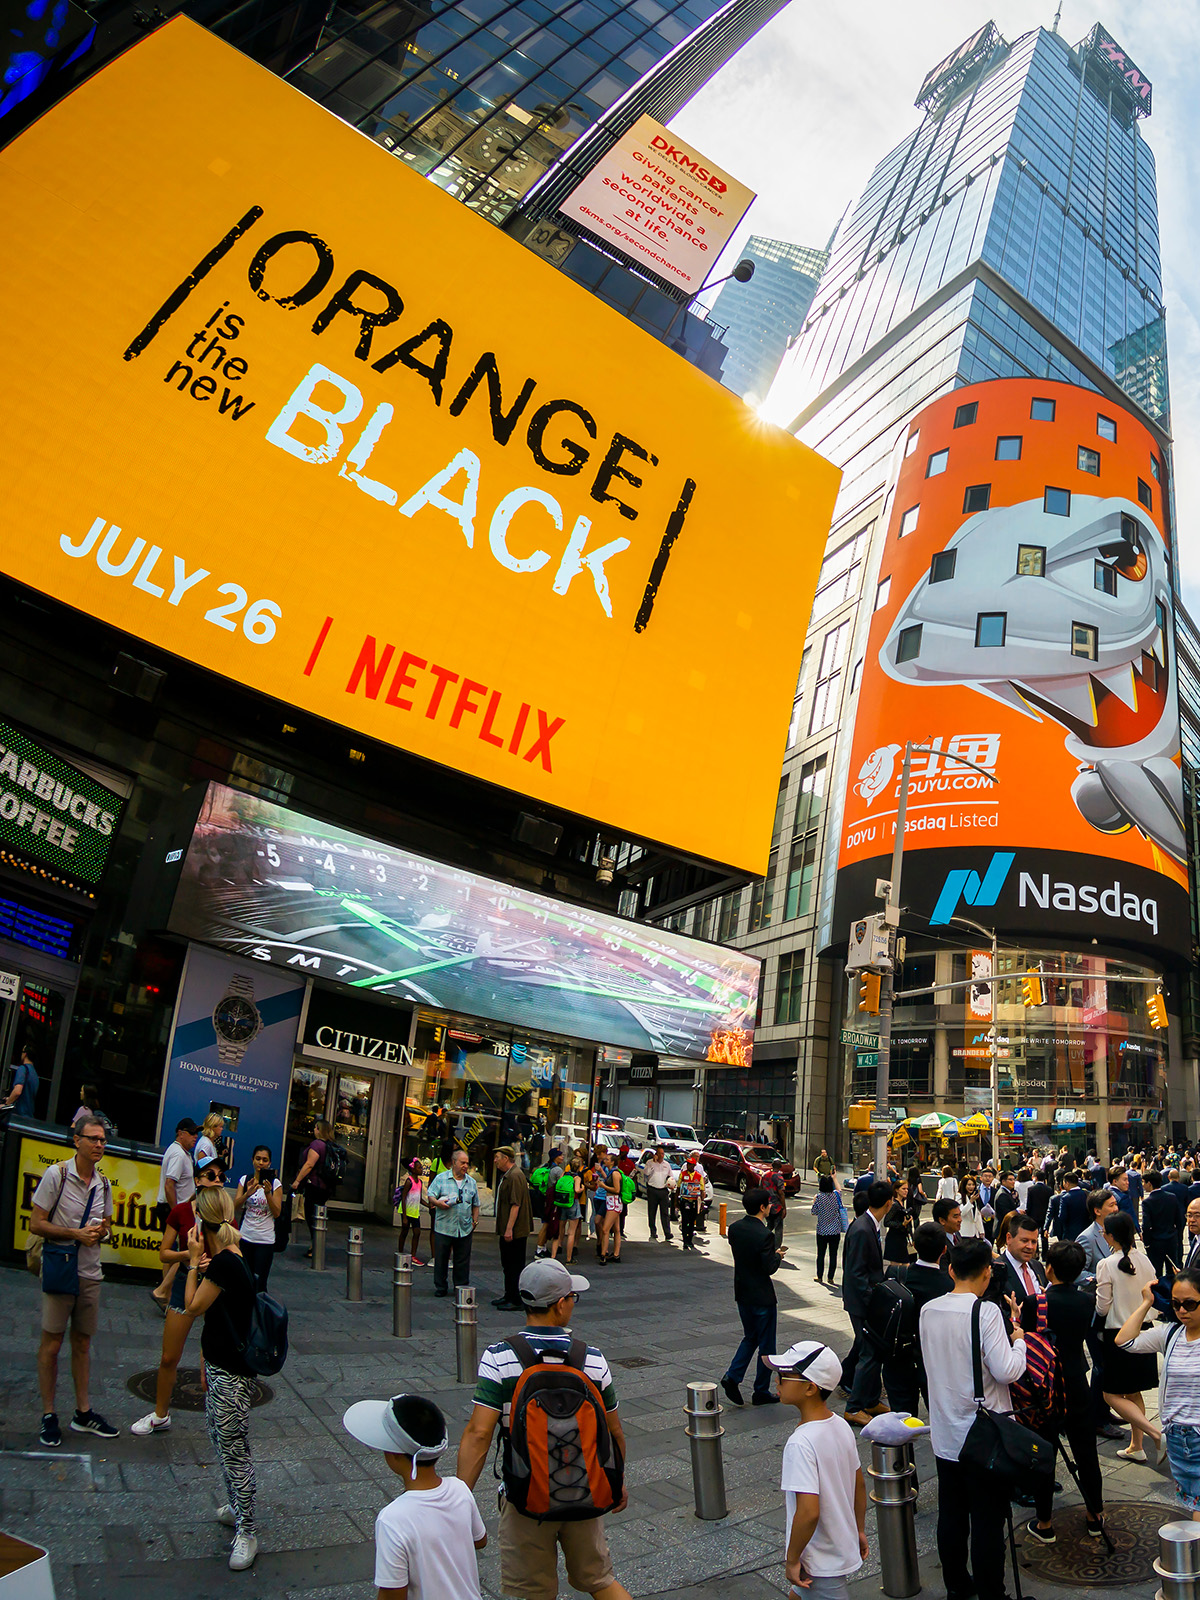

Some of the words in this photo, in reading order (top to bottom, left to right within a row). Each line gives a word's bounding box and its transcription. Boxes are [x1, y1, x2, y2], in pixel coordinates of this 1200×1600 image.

[650, 135, 710, 182] DKMS
[621, 171, 694, 226] worldwide
[697, 226, 706, 235] a
[632, 151, 676, 185] Giving
[679, 184, 724, 217] cancer
[641, 173, 699, 215] patients
[602, 177, 656, 215] second
[658, 211, 708, 252] chance
[625, 208, 641, 223] at
[644, 219, 669, 243] life.
[579, 205, 692, 281] dkms.org/secondchances
[208, 301, 245, 341] is
[188, 327, 249, 382] the
[248, 230, 659, 521] ORANGE
[164, 358, 256, 422] new
[265, 363, 630, 618] BLACK
[59, 516, 210, 607] JULY
[204, 582, 283, 645] 26
[345, 634, 566, 774] NETFLIX
[0, 786, 79, 853] OFFEE
[846, 826, 876, 849] DOYU
[892, 815, 946, 835] Nasdaq
[950, 812, 998, 828] Listed
[257, 844, 281, 867] -5
[315, 854, 336, 874] -4
[300, 835, 349, 853] MAO
[362, 849, 391, 864] RIO
[568, 910, 596, 923] ATH
[1018, 872, 1158, 936] Nasdaq
[316, 1025, 417, 1067] CITIZEN
[842, 1031, 878, 1047] BROADWAY
[953, 1049, 985, 1057] BRANDED
[984, 1035, 1010, 1044] Nadaq
[1021, 1037, 1049, 1045] REWRITE
[1052, 1038, 1086, 1046] TOMORROW
[179, 1061, 228, 1080] HONORING
[229, 1072, 247, 1085] THE
[248, 1076, 280, 1090] FINEST
[631, 1066, 653, 1079] CITIZEN
[858, 1056, 864, 1066] W
[864, 1055, 873, 1065] 43
[199, 1075, 211, 1083] THIN
[212, 1077, 225, 1086] BLUE
[225, 1080, 238, 1089] LINE
[238, 1083, 258, 1093] WATCH
[1014, 1078, 1047, 1089] Nasdaq
[38, 1154, 55, 1165] Your
[121, 1232, 163, 1251] Musica
